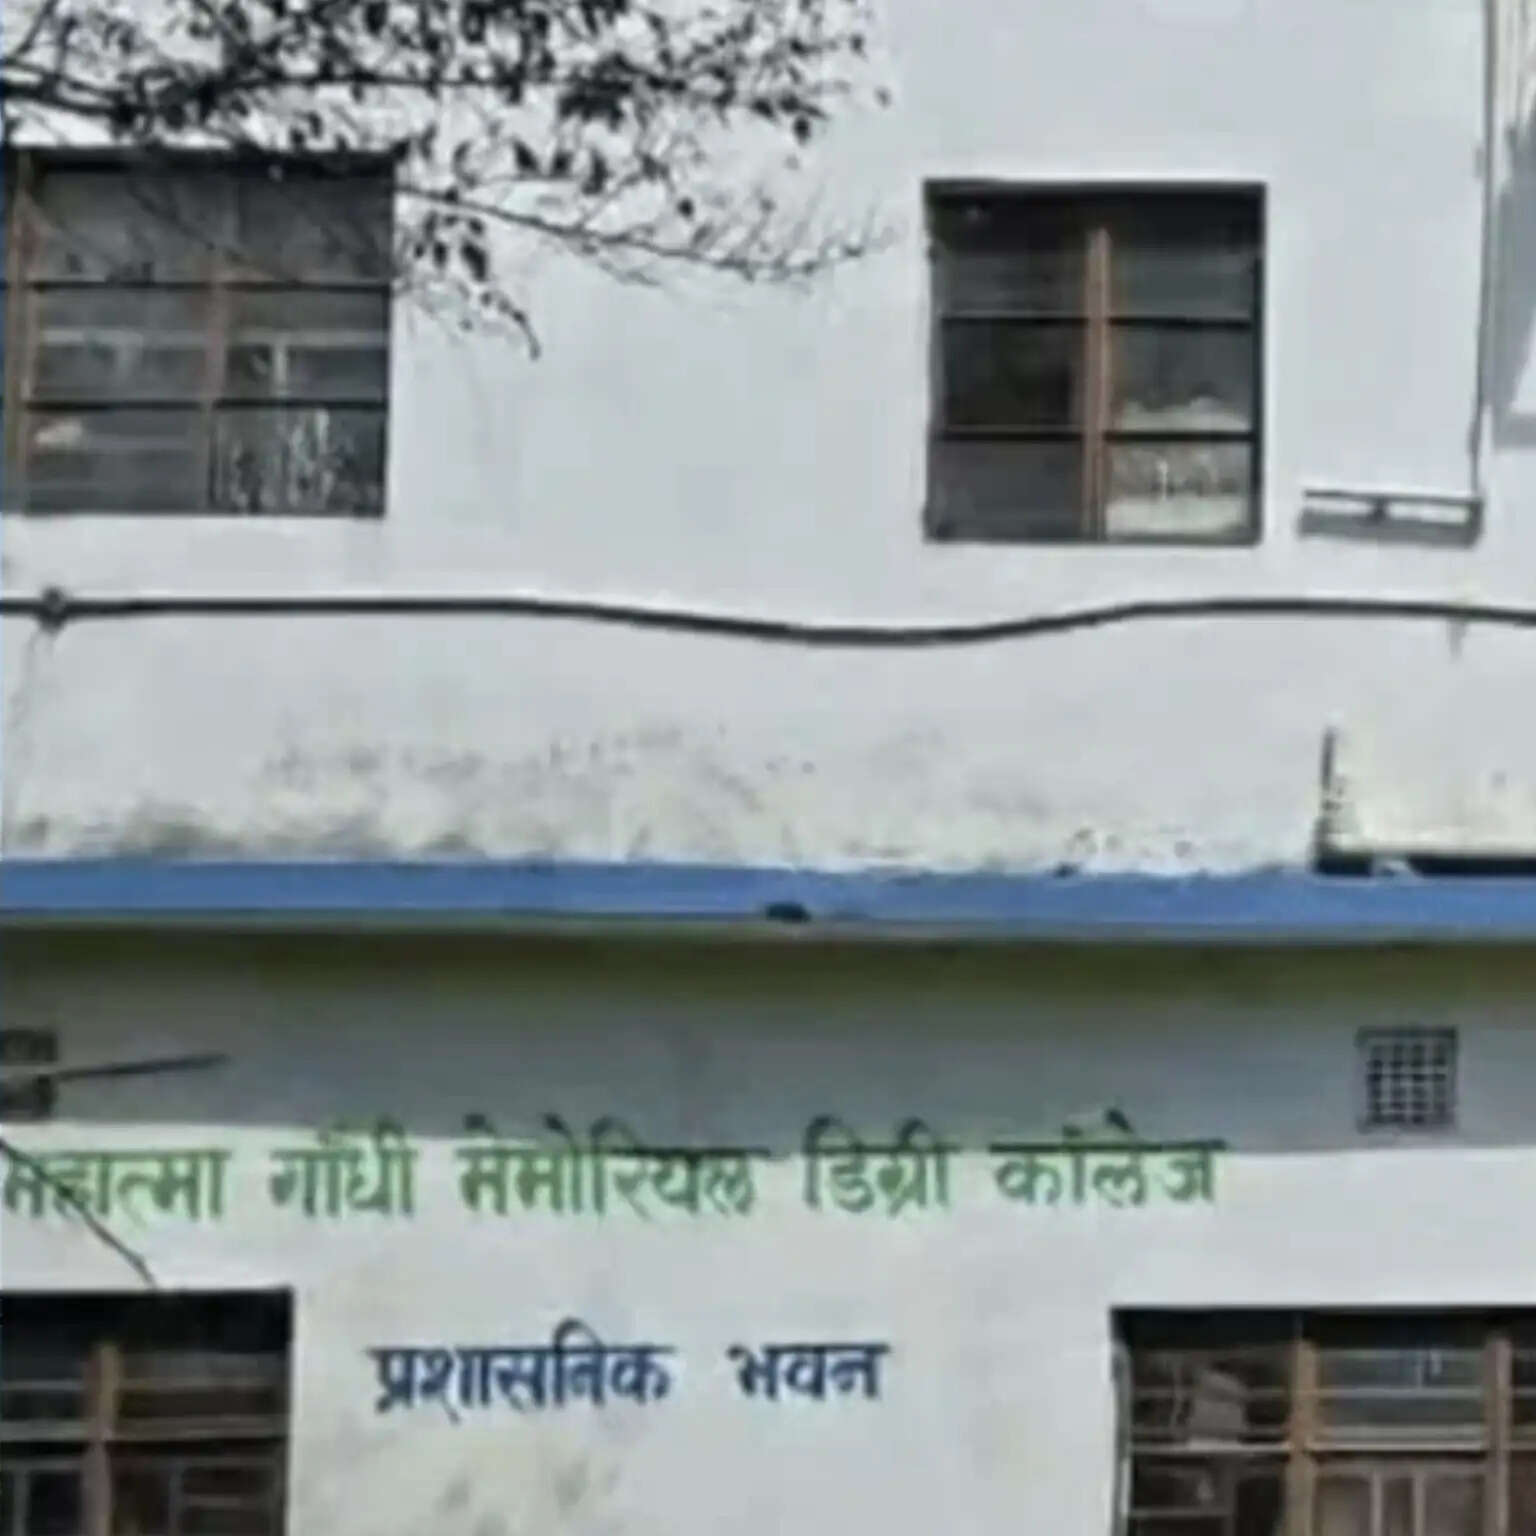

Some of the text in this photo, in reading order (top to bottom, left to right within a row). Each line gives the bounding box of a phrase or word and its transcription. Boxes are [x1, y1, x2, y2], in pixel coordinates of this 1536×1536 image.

[459, 1112, 763, 1223] मेमोरियल
[801, 1115, 955, 1220] डिग्री
[990, 1108, 1227, 1217] कॉलेज
[368, 1319, 891, 1424] प्रशासनिक भवन
